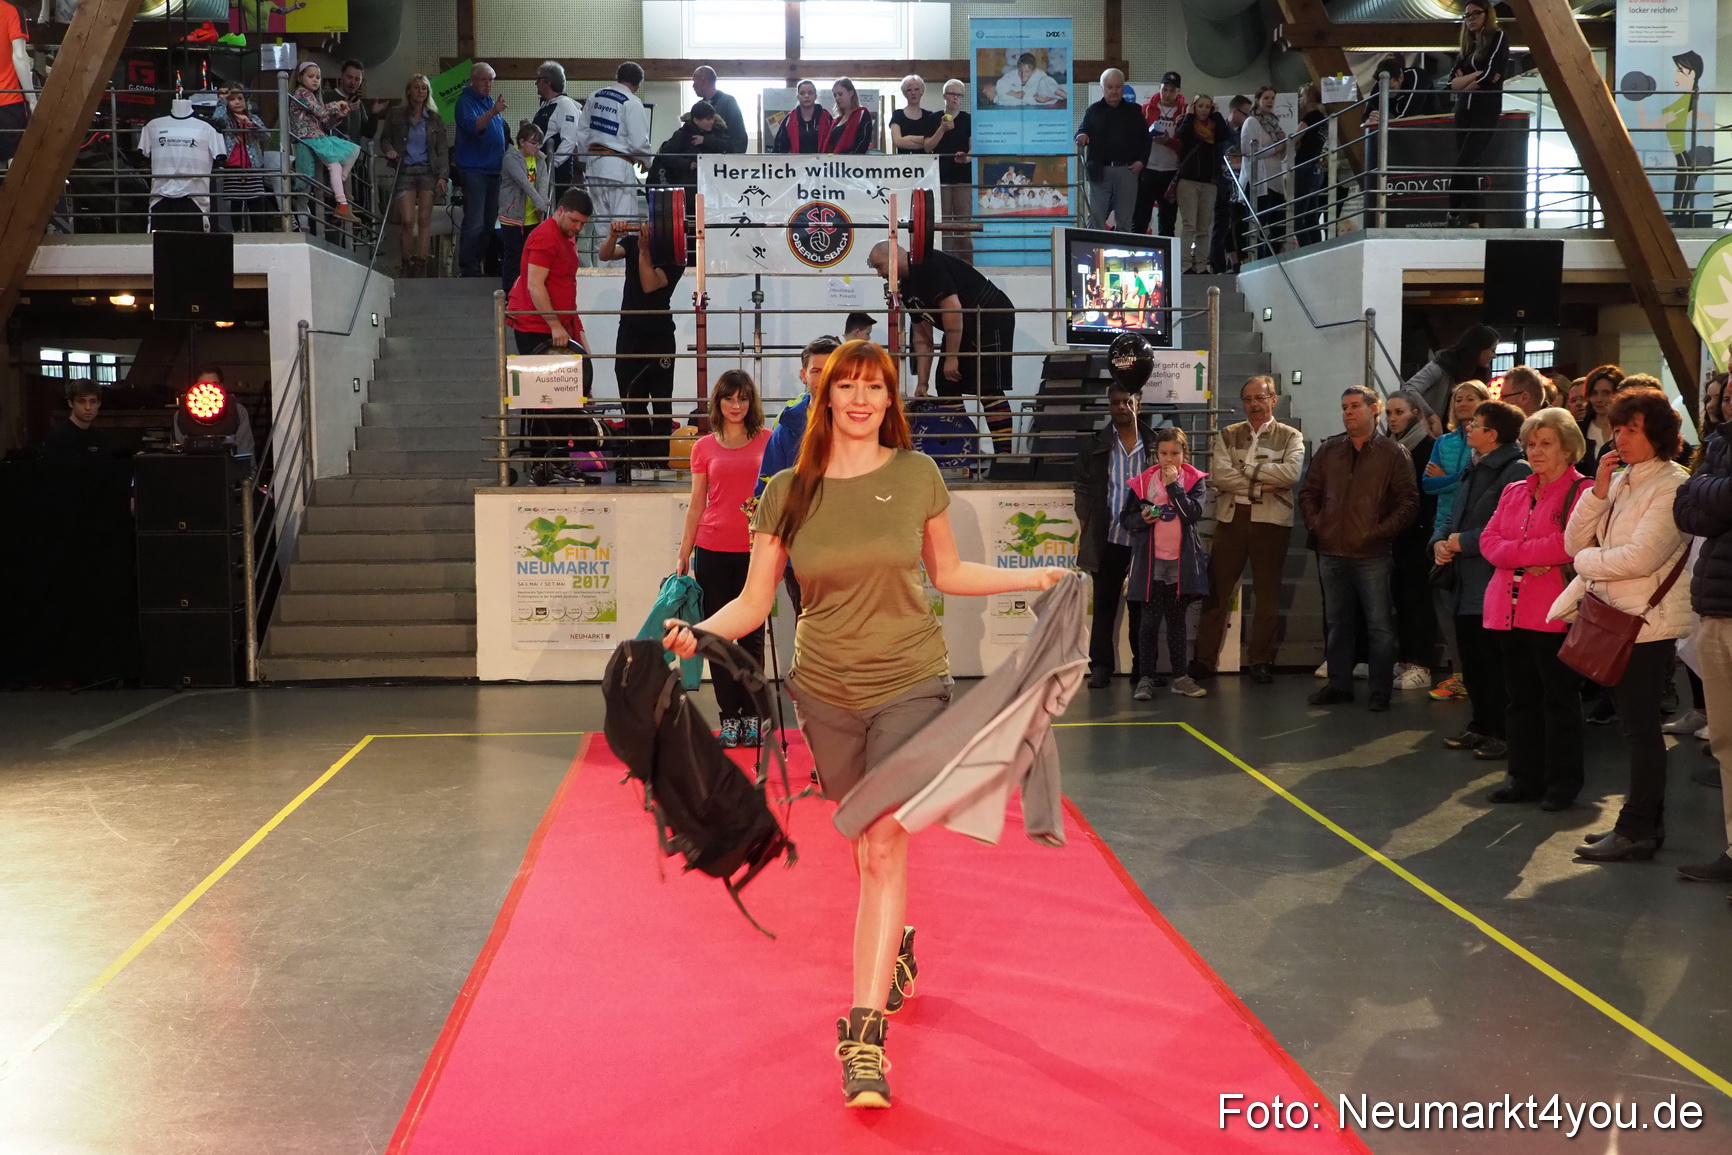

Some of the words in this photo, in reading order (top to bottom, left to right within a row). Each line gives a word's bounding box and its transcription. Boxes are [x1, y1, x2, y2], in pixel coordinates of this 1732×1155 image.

[594, 102, 617, 114] Bayern
[713, 163, 796, 179] Herzlich
[805, 162, 925, 179] willkommen
[797, 184, 845, 200] beim
[1387, 179, 1428, 196] BODY
[806, 207, 837, 235] SC
[791, 232, 849, 263] OBERÖLSBACH
[1162, 362, 1178, 370] geht
[565, 547, 590, 560] FIT
[594, 547, 610, 560] IN
[1043, 541, 1067, 554] FIT
[517, 561, 609, 575] NEUMARKT
[997, 555, 1078, 569] NEUMARK
[572, 575, 610, 589] 2017
